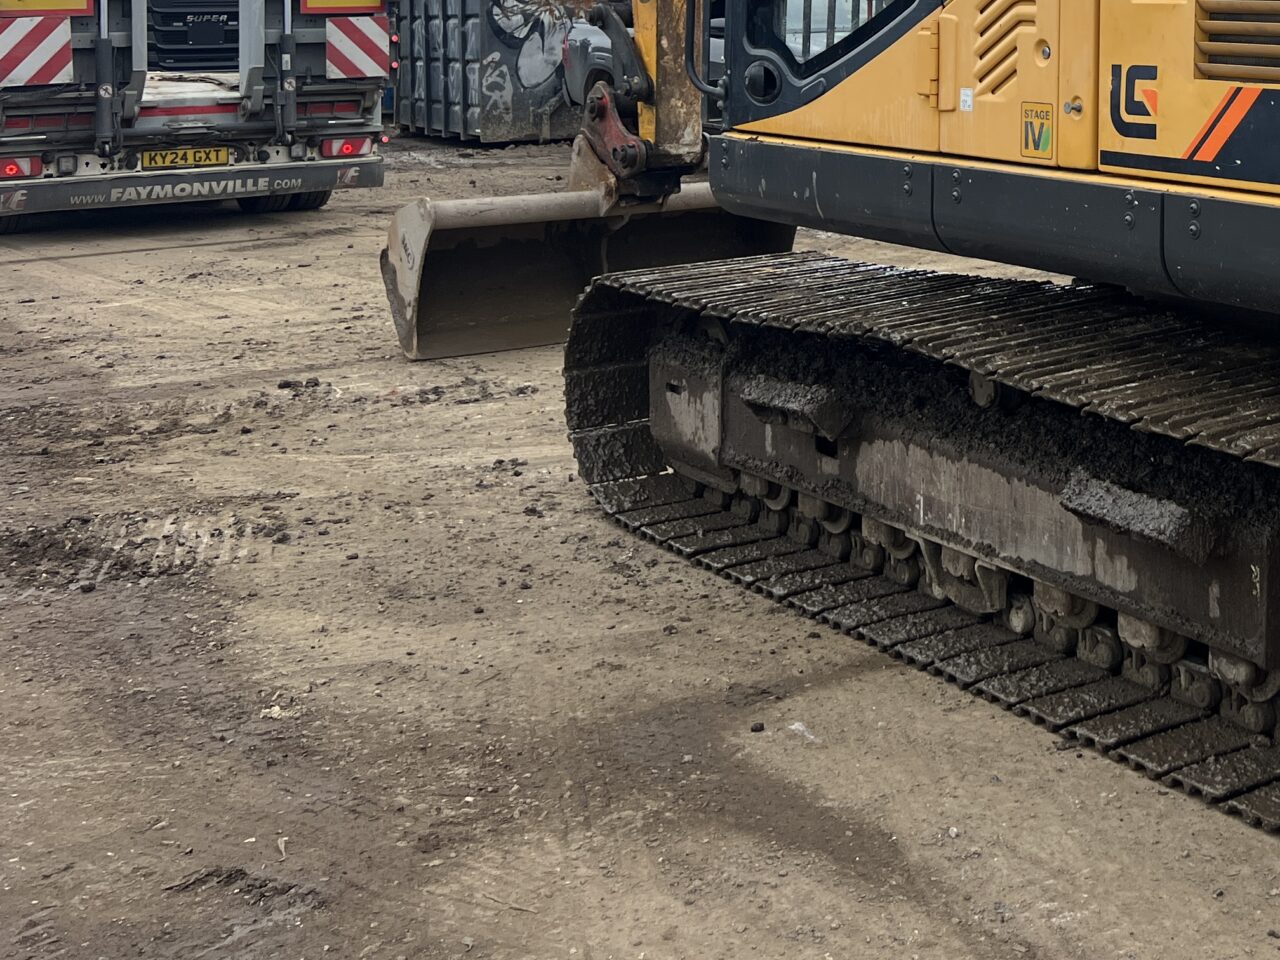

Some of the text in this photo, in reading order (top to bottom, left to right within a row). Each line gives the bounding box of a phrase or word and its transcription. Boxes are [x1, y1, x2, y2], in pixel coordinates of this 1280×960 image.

[186, 14, 228, 22] SUPER
[1024, 109, 1051, 120] STAGE
[1024, 120, 1045, 151] IV
[148, 148, 222, 166] KY24 GXT
